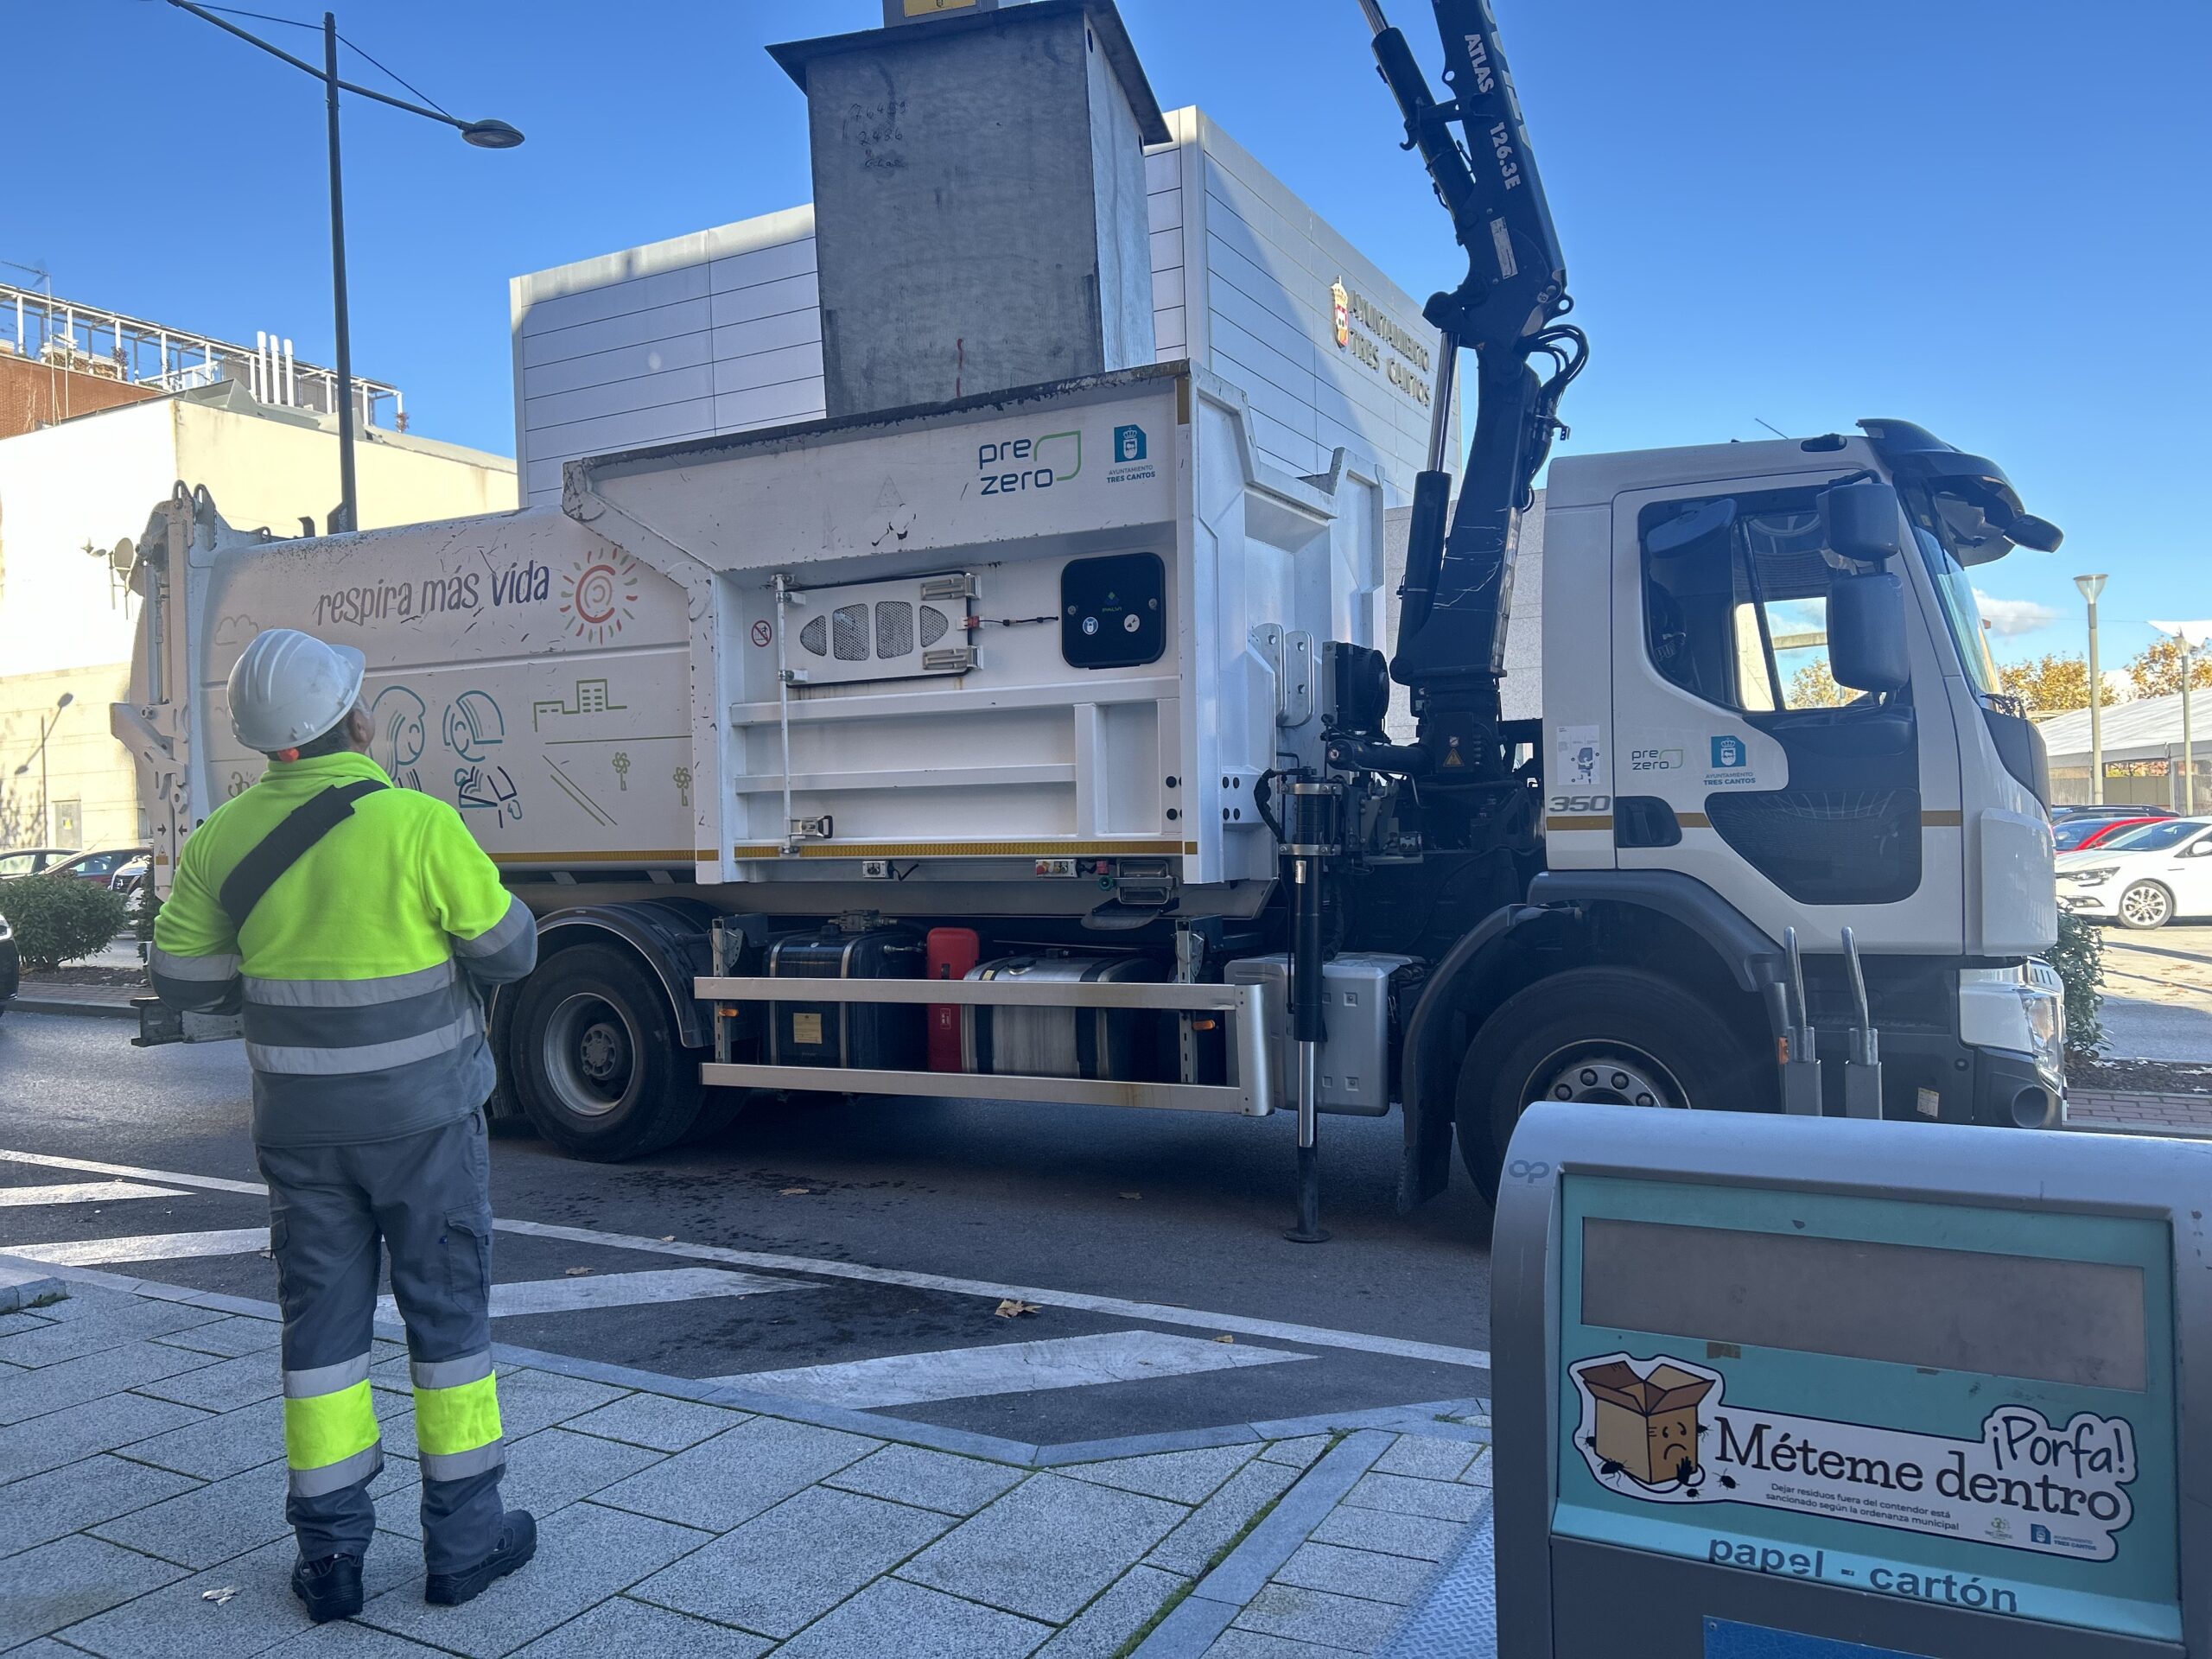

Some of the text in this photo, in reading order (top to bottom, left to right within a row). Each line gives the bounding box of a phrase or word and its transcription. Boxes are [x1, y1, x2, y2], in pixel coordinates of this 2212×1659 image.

[1465, 34, 1494, 93] ATLAS
[1490, 121, 1521, 190] 126.3E
[1349, 290, 1430, 373] AYUNTAMIENTO
[1350, 328, 1430, 409] TRES CANTOS
[979, 439, 1032, 470] pre
[1109, 465, 1154, 475] AYUNTAMIENTO
[981, 468, 1053, 495] zero
[1107, 471, 1156, 484] TRES CANTOS
[317, 560, 550, 626] respira más vida
[1631, 749, 1659, 761] pre
[1632, 760, 1669, 771] zero
[1548, 795, 1611, 812] 350
[1991, 1415, 2126, 1478] ¡Porfa!
[1714, 1416, 2121, 1521] Méteme dentro
[1765, 1493, 1817, 1508] sancionado
[1819, 1503, 1847, 1516] según
[1859, 1509, 1910, 1522] ordenanza
[1912, 1516, 1959, 1531] municipal
[1771, 1484, 1951, 1519] Dejar residuos fuera del contendor está
[1709, 1539, 1823, 1578] papel
[1869, 1566, 2017, 1613] cartón
